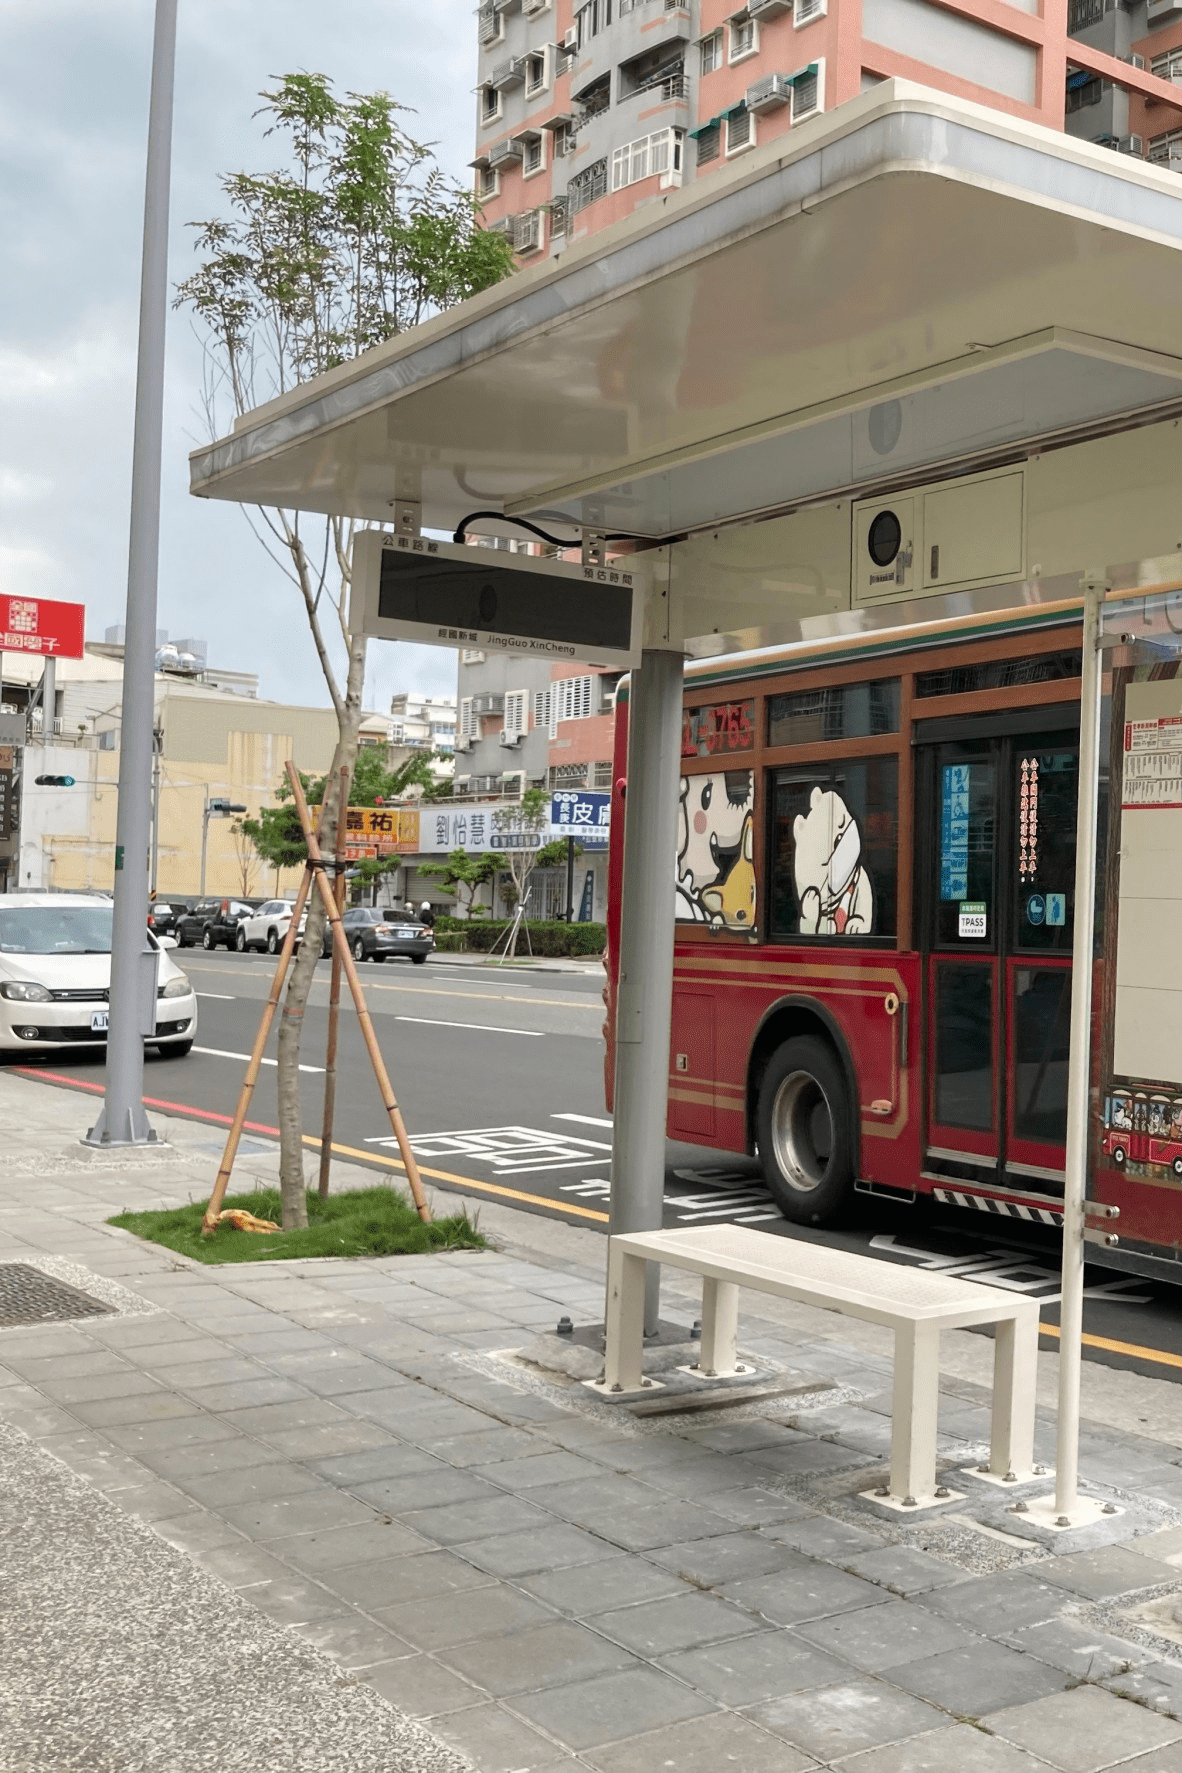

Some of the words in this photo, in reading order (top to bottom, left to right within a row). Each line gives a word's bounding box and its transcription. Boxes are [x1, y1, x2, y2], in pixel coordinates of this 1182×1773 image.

[382, 534, 439, 554] 公車路線
[584, 567, 633, 586] 預估時間
[0, 632, 60, 652] 國電子
[438, 628, 478, 642] 經國新城
[487, 634, 528, 648] JingGuo
[529, 639, 576, 656] XinCheng
[436, 813, 486, 846] 劉怡慧
[961, 917, 985, 927] TPASS
